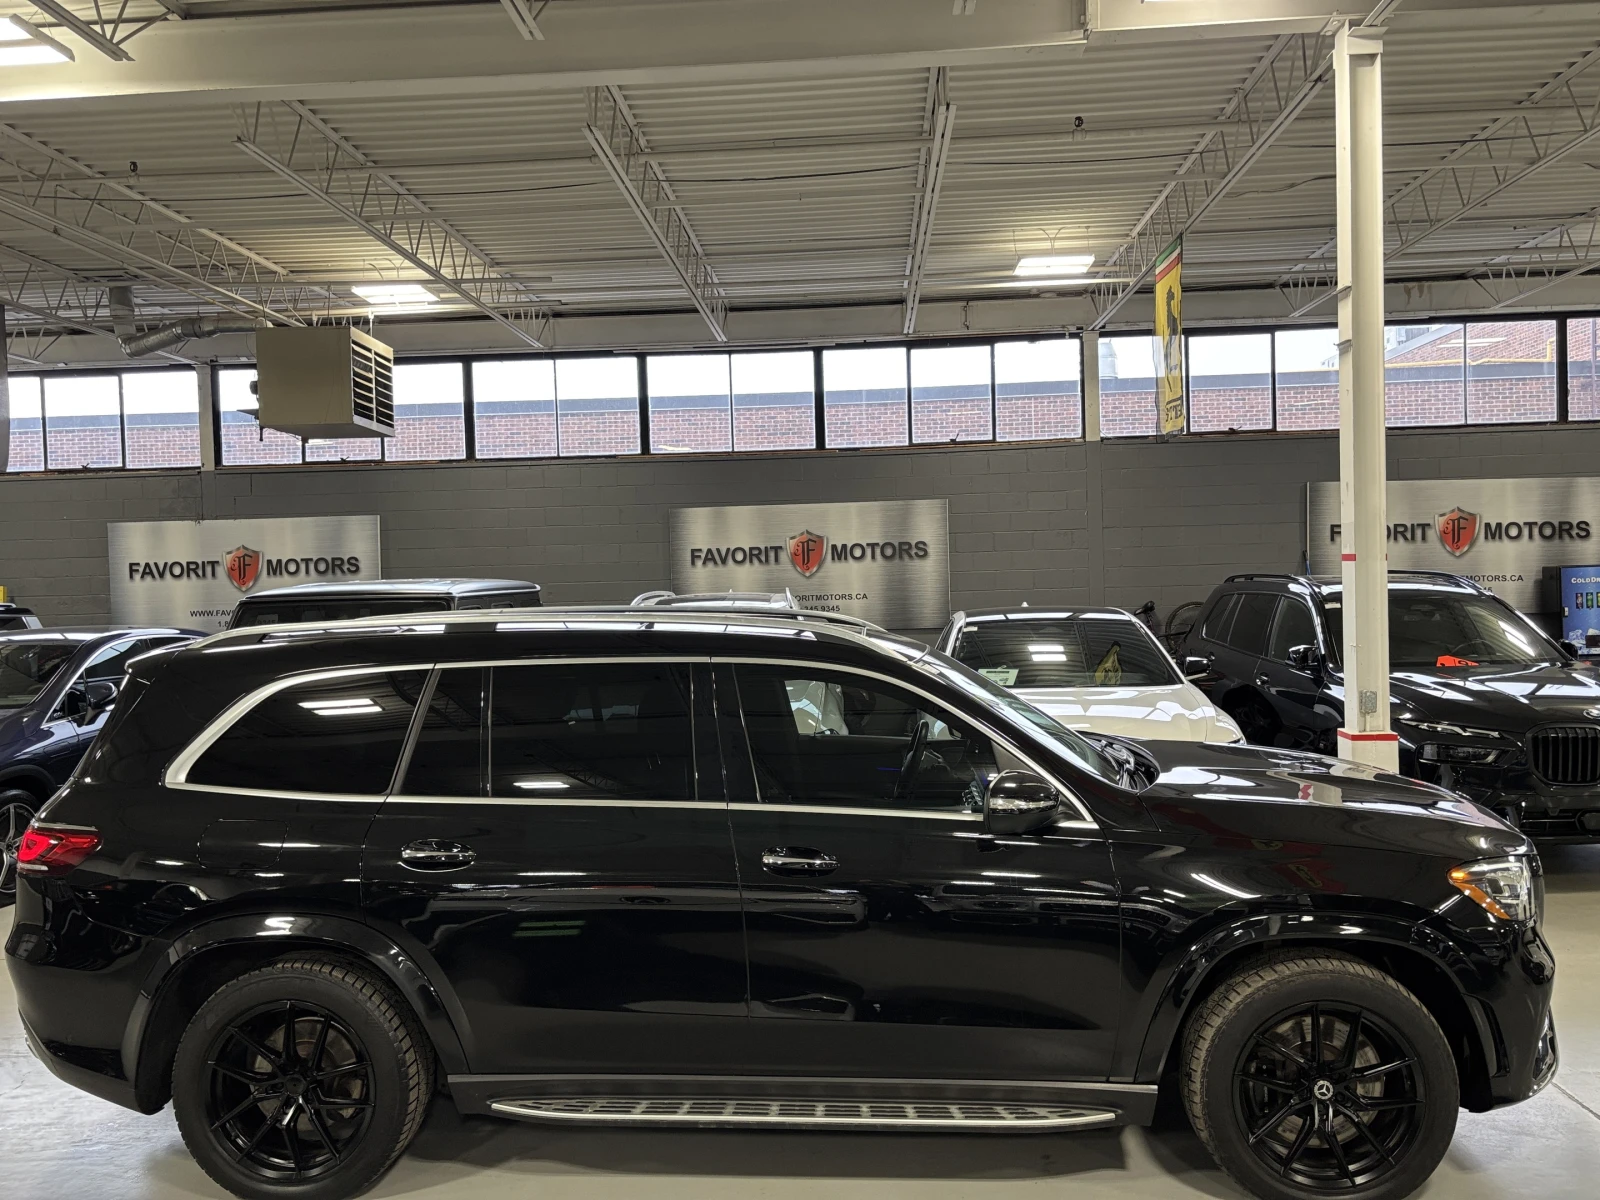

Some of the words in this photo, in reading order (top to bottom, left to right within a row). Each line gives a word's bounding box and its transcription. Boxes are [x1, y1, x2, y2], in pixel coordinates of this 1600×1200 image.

[1330, 523, 1431, 542] FRIT
[1484, 521, 1591, 540] MOTORS
[690, 545, 783, 565] FAVORIT
[831, 541, 928, 561] MOTORS
[128, 560, 219, 580] FAVORIT
[266, 556, 360, 576] MOTORS
[793, 593, 868, 602] ORITMOTORS.CA
[190, 609, 235, 617] WWW.FAV
